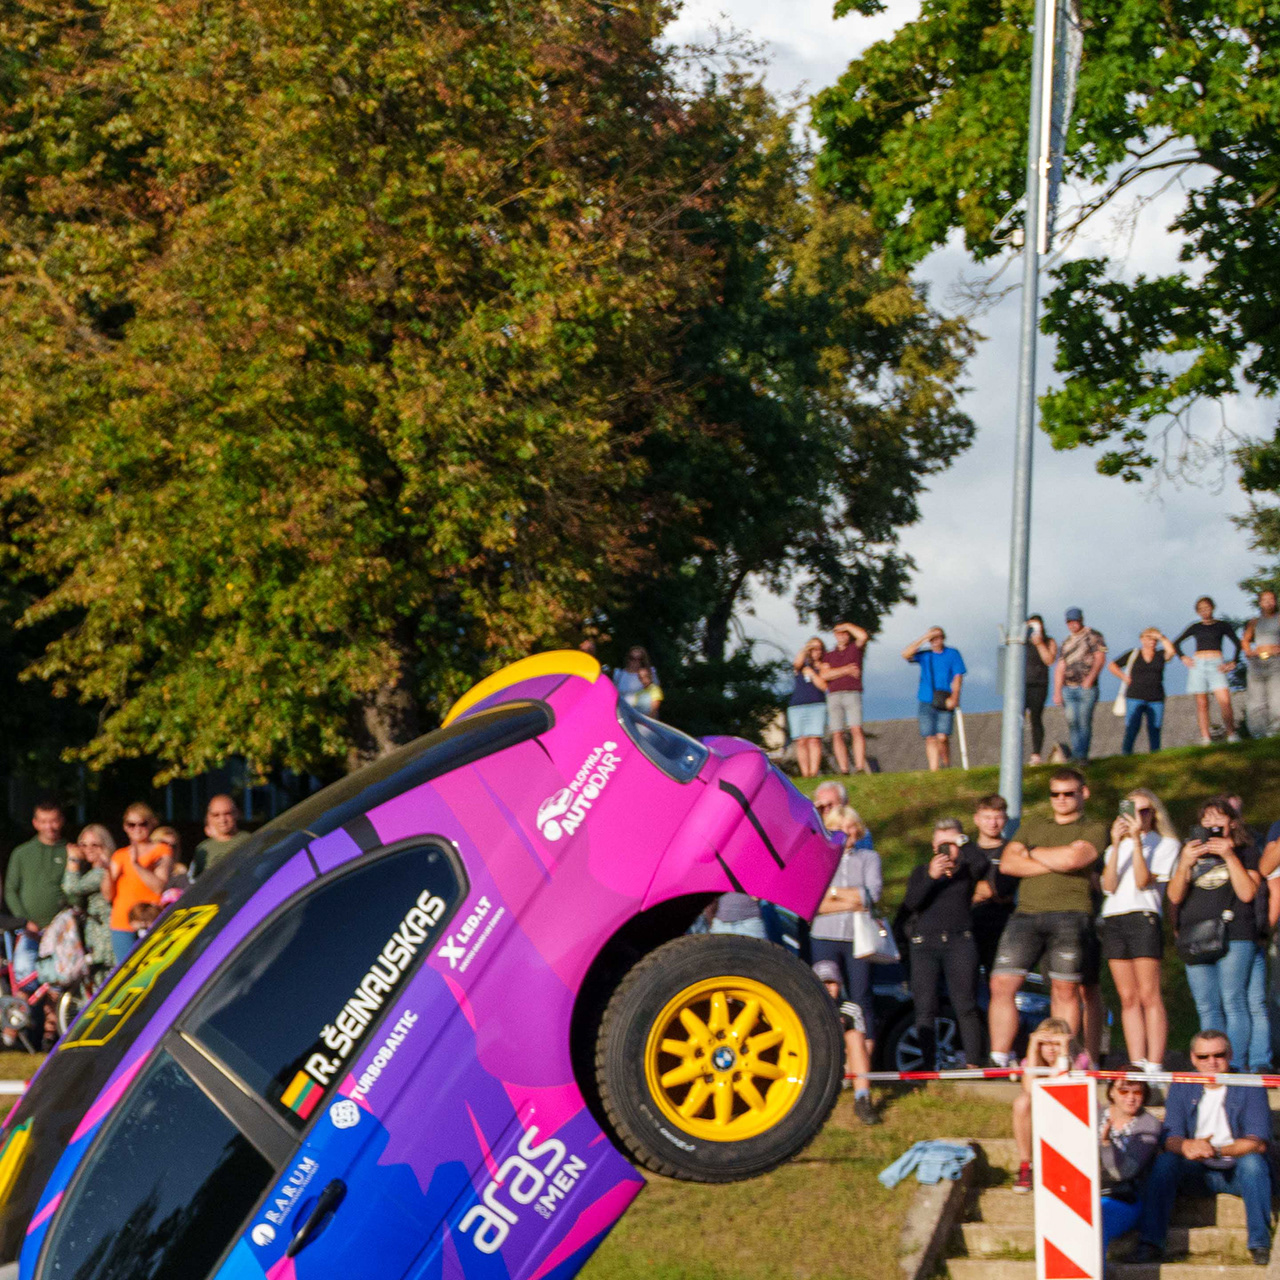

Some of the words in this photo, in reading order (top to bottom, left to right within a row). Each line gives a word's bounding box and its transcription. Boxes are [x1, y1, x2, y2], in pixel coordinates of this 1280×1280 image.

[456, 895, 492, 944] LED.LT
[319, 889, 446, 1058] ŠEINAUSKAS
[303, 1052, 342, 1085] R.
[350, 1009, 419, 1101] TURBOBALTIC
[264, 1156, 316, 1226] RARUM
[458, 1125, 566, 1254] aras
[538, 1154, 587, 1212] MEN
